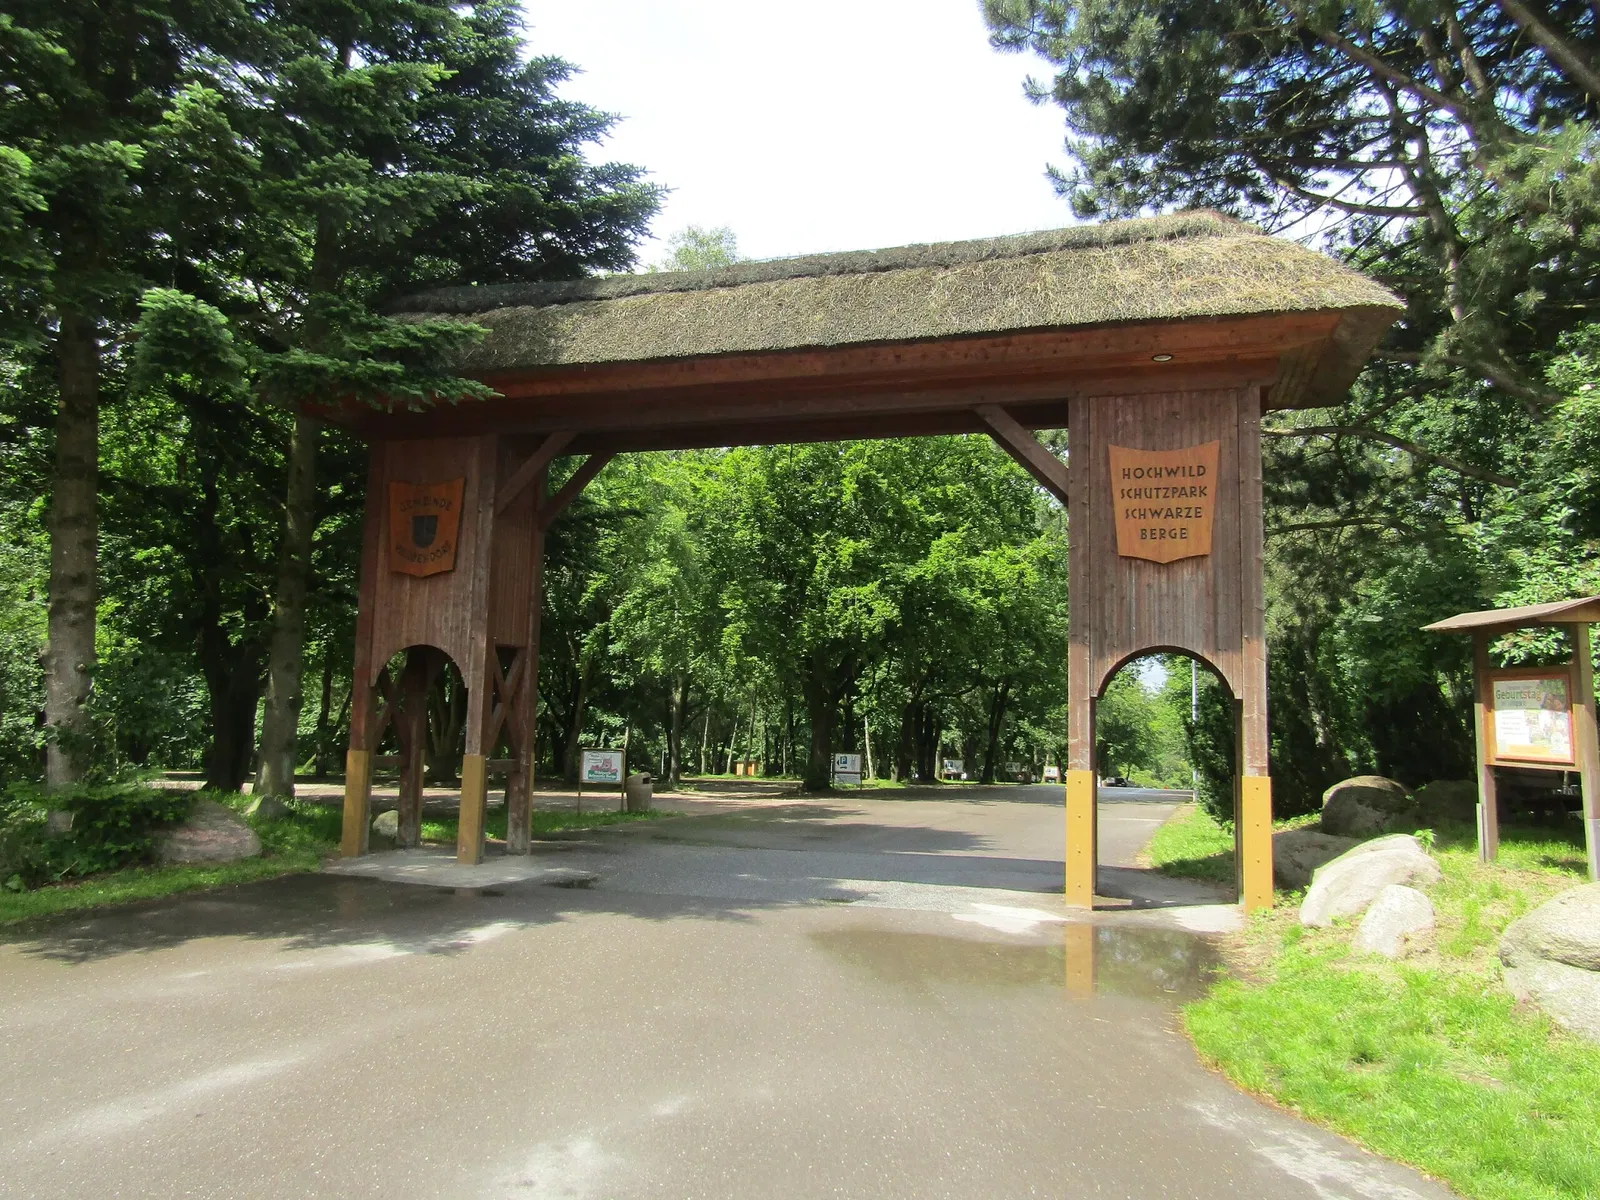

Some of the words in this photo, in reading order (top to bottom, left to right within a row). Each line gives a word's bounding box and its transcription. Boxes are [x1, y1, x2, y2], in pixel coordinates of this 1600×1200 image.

[1122, 465, 1206, 480] HOCHWILD
[1120, 486, 1208, 500] SCHUTZPARK
[1125, 506, 1203, 520] SCHWARZE
[1140, 527, 1188, 541] BERGE
[1495, 689, 1541, 702] Geburtstag
